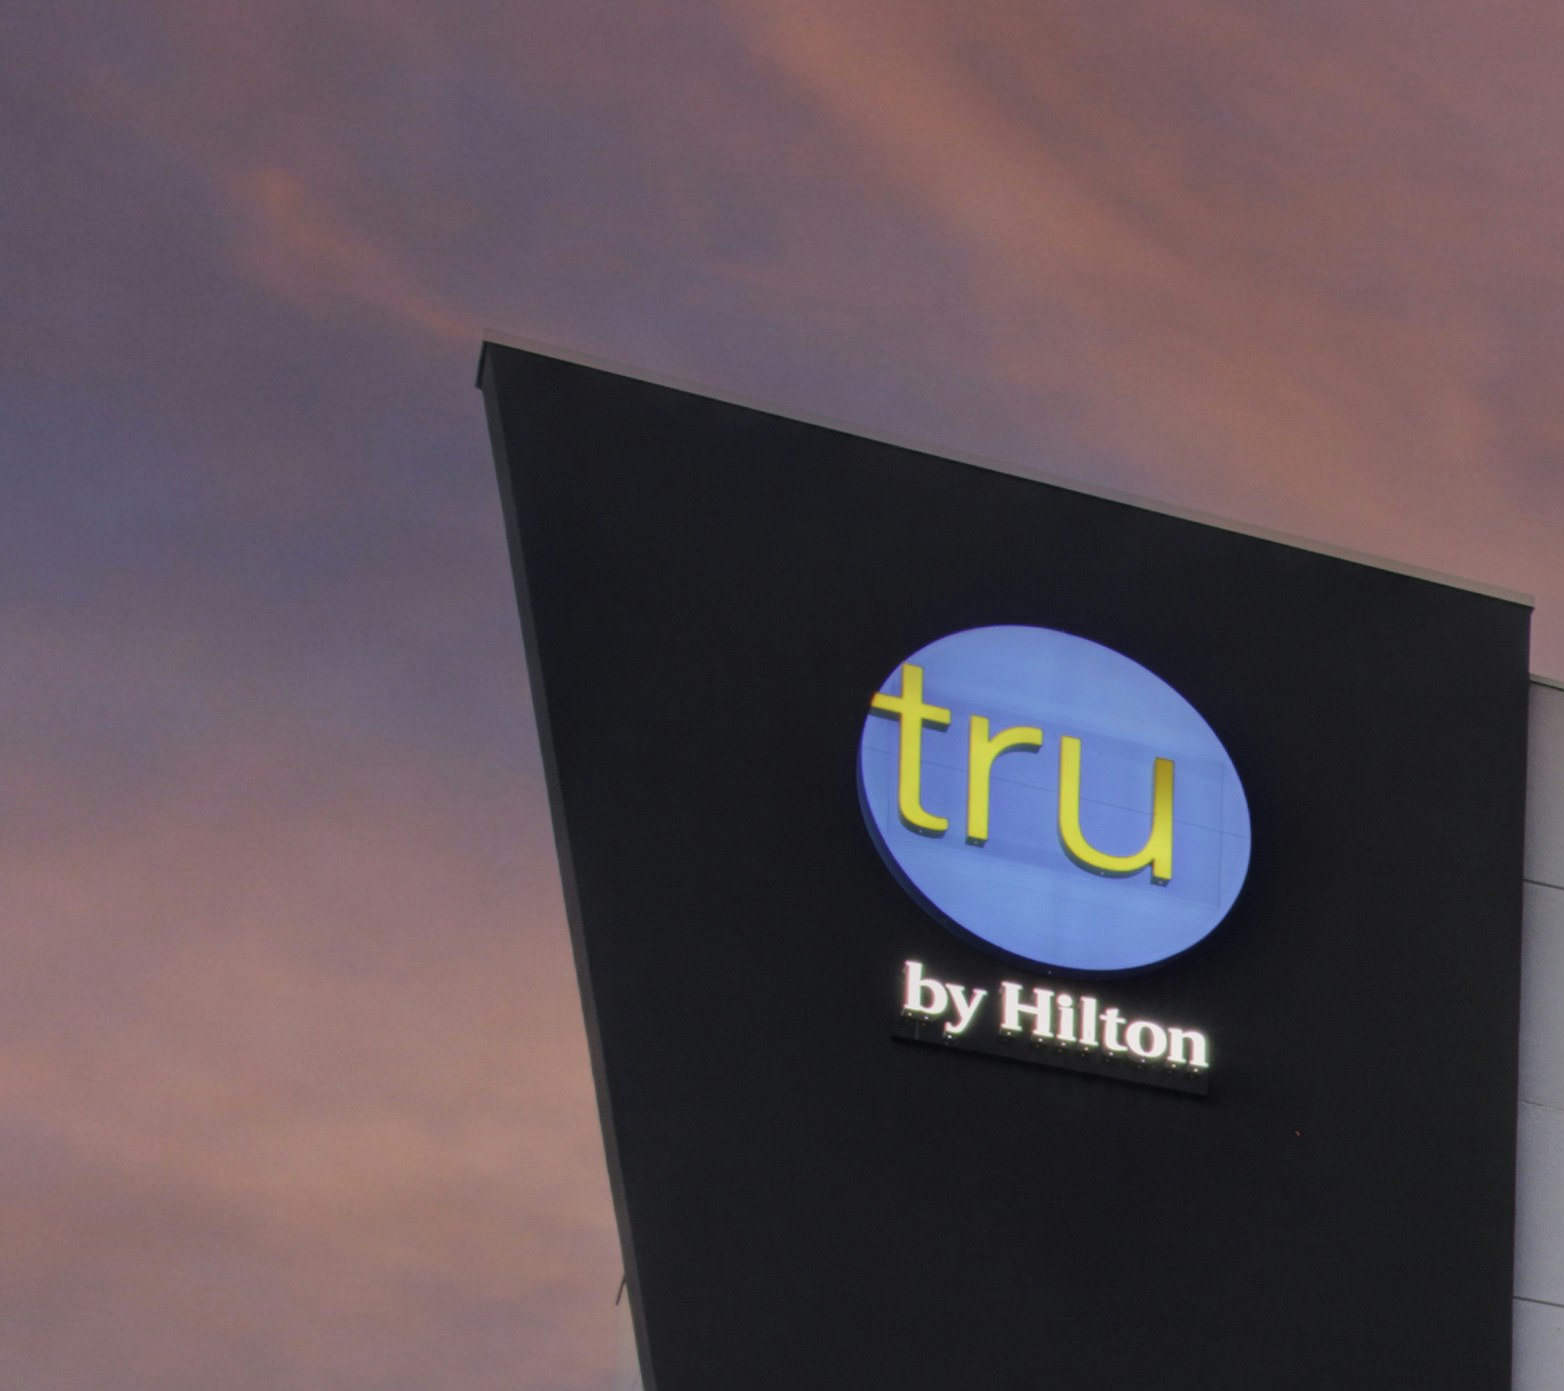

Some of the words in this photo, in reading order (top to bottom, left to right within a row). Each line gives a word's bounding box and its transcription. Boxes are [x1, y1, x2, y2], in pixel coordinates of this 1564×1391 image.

[870, 662, 1175, 886] tru
[903, 960, 987, 1034] by
[1001, 980, 1209, 1068] Hilton
